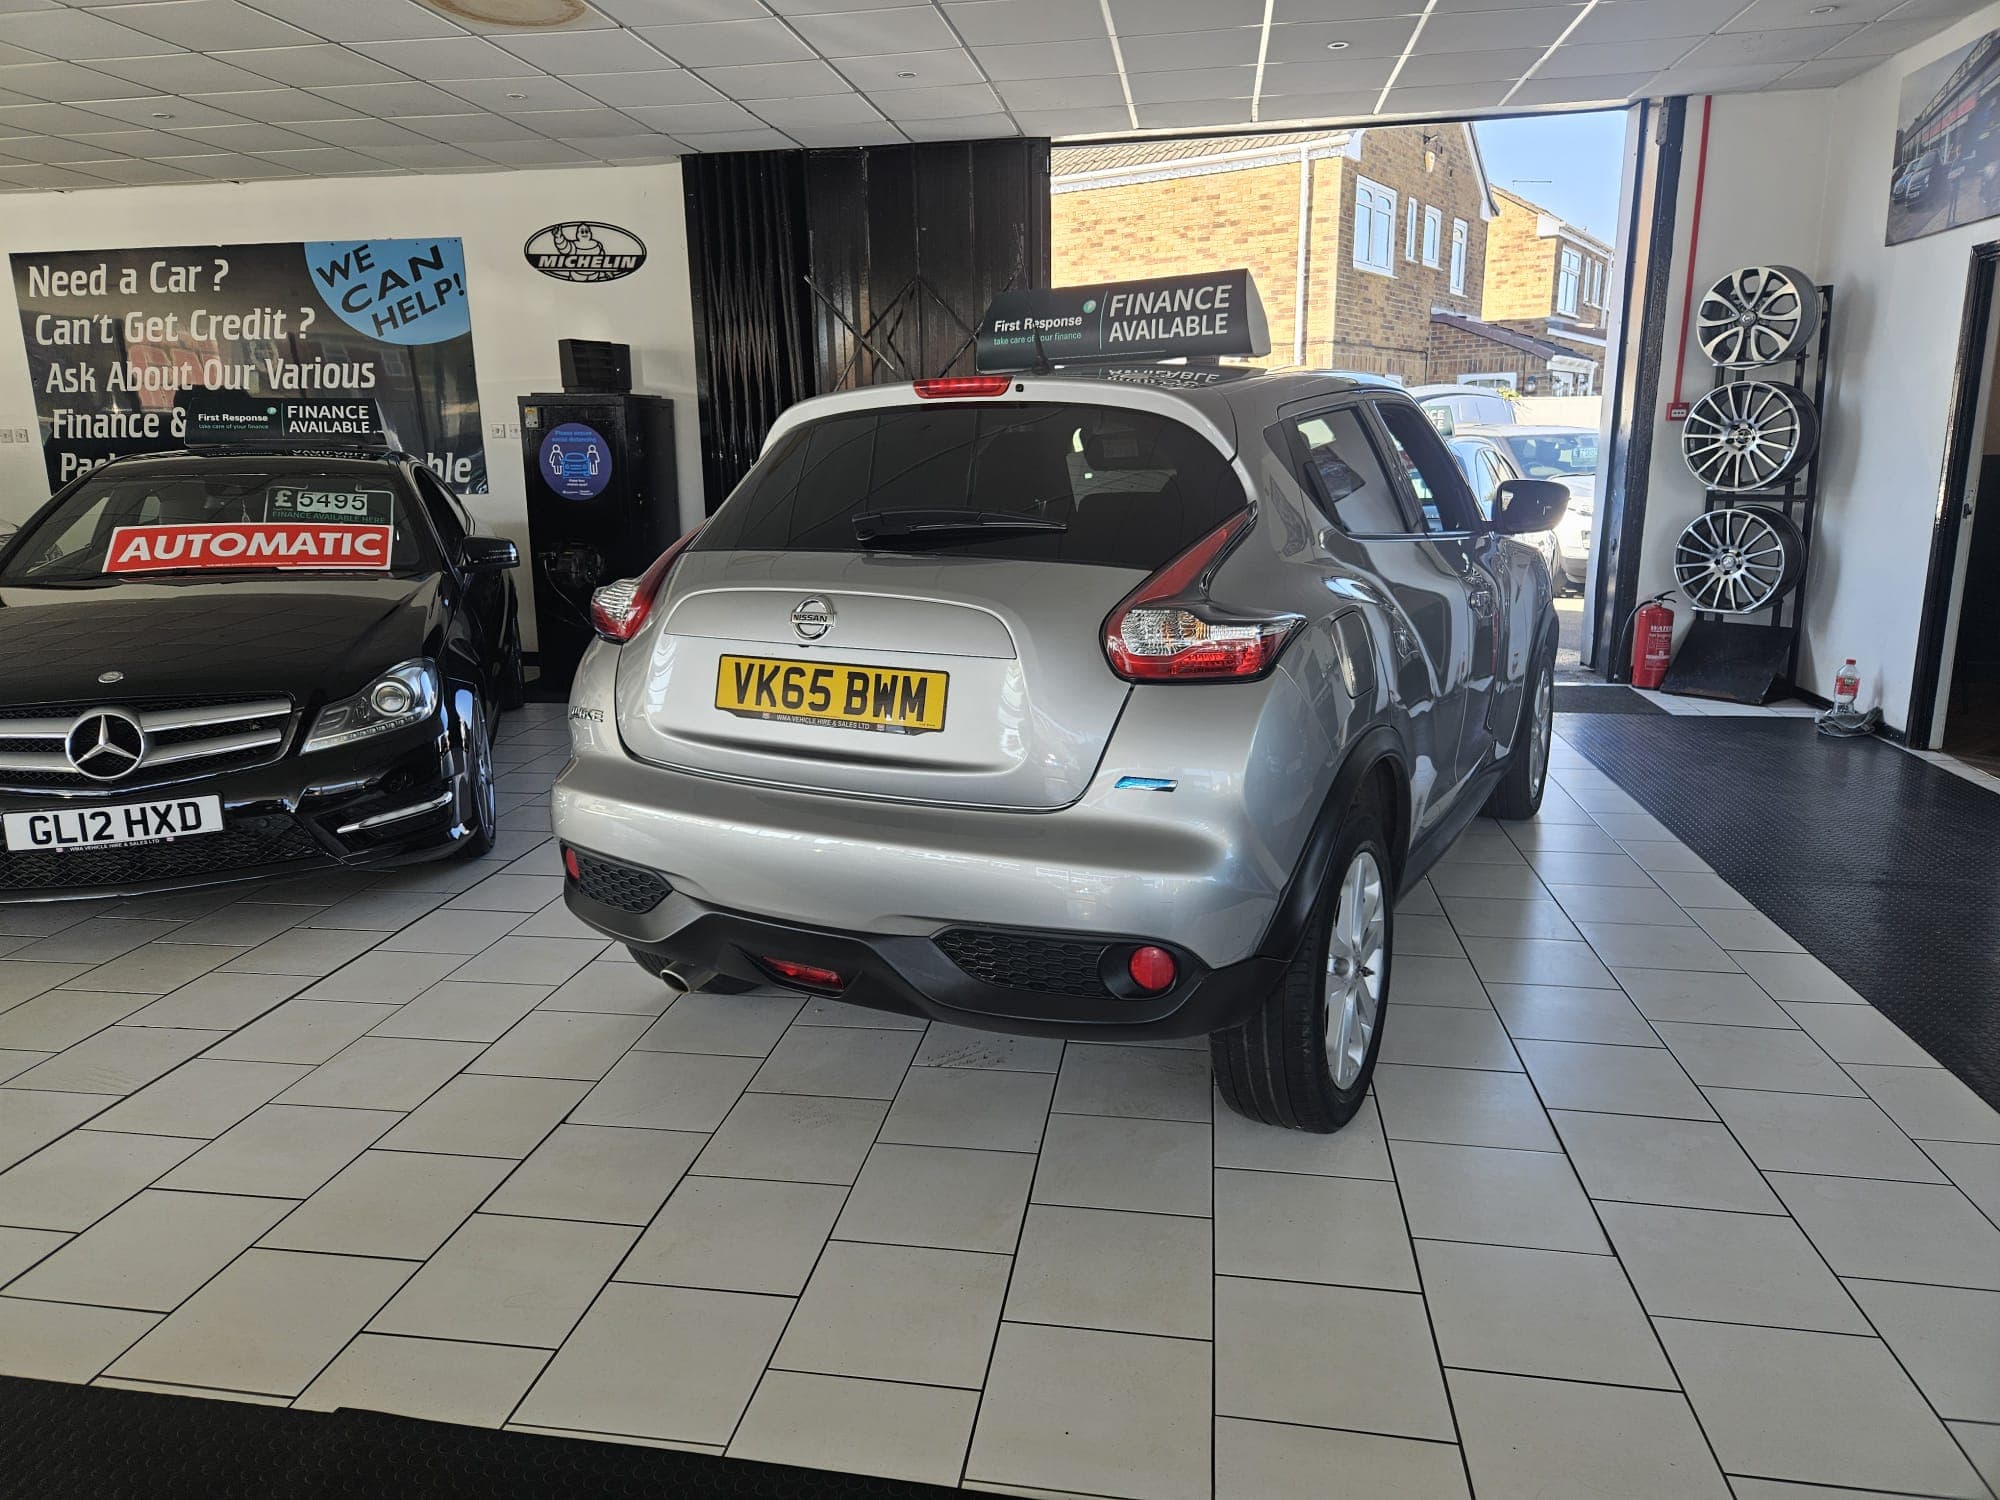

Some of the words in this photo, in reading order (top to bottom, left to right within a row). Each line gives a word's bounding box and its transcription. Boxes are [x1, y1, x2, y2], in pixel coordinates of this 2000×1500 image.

[316, 244, 375, 287] WE
[538, 255, 637, 269] MICHELIN
[28, 263, 108, 298] Need
[119, 268, 138, 294] a
[150, 261, 202, 294] Car
[213, 259, 229, 292] ?
[341, 245, 444, 314] CAN
[371, 273, 464, 337] HELP!
[1109, 284, 1233, 317] FINANCE
[36, 313, 114, 346] Can't
[125, 312, 179, 344] Get
[190, 307, 287, 342] Credit
[299, 307, 316, 339] ?
[994, 319, 1020, 333] First
[1023, 316, 1083, 331] Response
[994, 336, 1009, 346] take
[1010, 336, 1026, 345] care
[1026, 334, 1036, 343] of
[1040, 333, 1053, 342] our
[1054, 332, 1082, 341] finance
[1108, 312, 1229, 343] AVAILABLE
[46, 361, 97, 394] Ask
[106, 360, 193, 392] About
[203, 358, 256, 392] Our
[264, 356, 376, 390] Various
[53, 408, 160, 439] Finance
[170, 406, 187, 438] &
[198, 413, 220, 422] First
[222, 413, 269, 423] Response
[287, 405, 369, 419] FINANCE
[289, 420, 370, 434] AVAILABLE
[272, 511, 312, 520] FINANCE
[313, 513, 361, 522] AVAILABLE
[361, 515, 385, 523] HERE
[117, 532, 383, 563] AUTOMATIC
[793, 613, 828, 623] NISSAN
[734, 661, 835, 713] VK65
[843, 670, 928, 722] BWM
[791, 715, 817, 725] VEHICLE
[817, 718, 830, 727] HIRE
[838, 720, 857, 729] SALES
[29, 810, 114, 845] GL12
[124, 801, 202, 839] HXD
